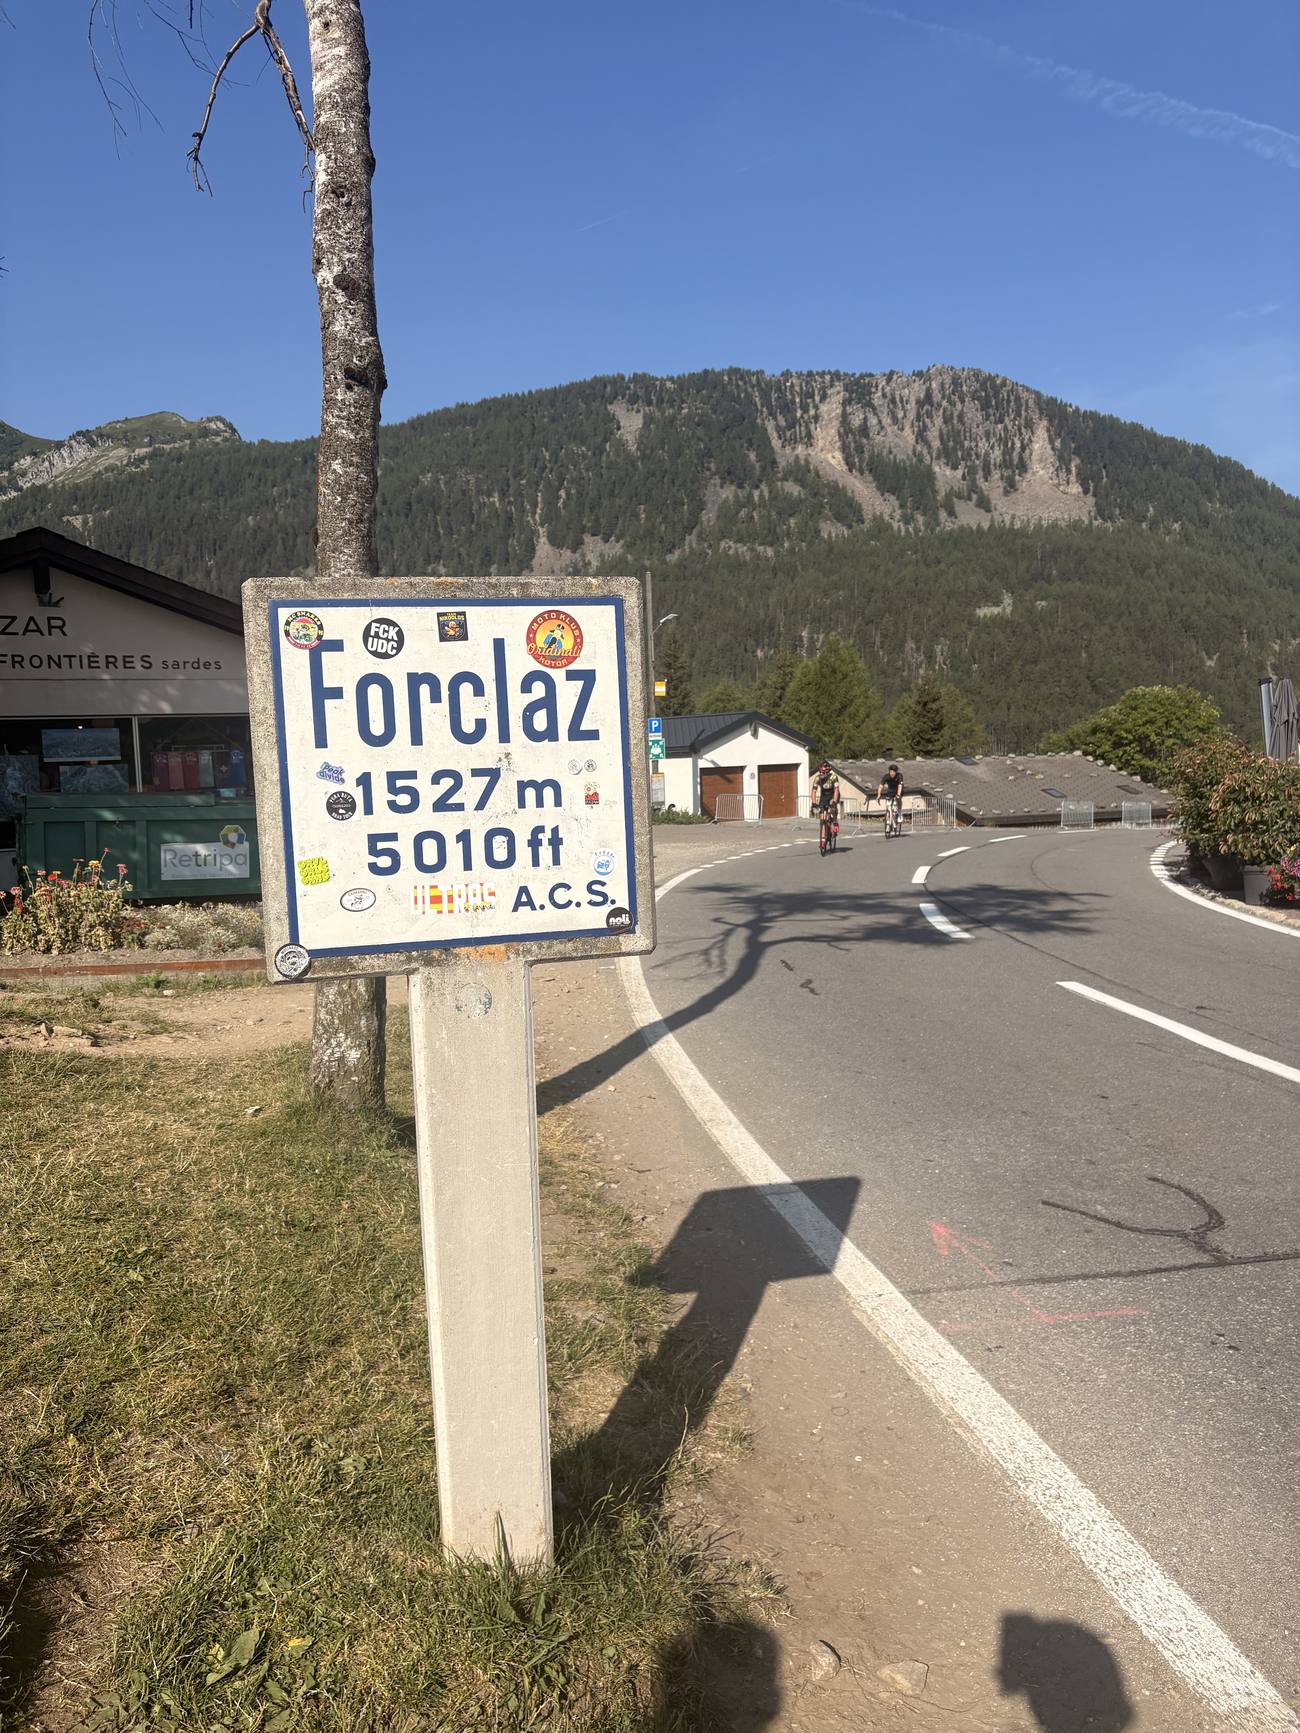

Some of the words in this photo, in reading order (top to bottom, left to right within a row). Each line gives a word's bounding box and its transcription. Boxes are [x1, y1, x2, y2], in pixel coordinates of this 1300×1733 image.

[0, 615, 68, 637] ZAR
[370, 622, 400, 641] FCK
[532, 612, 557, 630] MOTO
[559, 613, 580, 637] KLUB
[367, 636, 398, 656] UDC
[0, 652, 153, 670] FRONTIÈRES
[161, 658, 222, 670] sardes
[308, 637, 600, 749] Forclaz
[355, 767, 502, 816] 1527
[516, 778, 563, 809] m
[162, 848, 248, 872] Retripa
[367, 826, 517, 877] 5010
[527, 824, 564, 868] ft
[511, 880, 617, 913] A.C.S.
